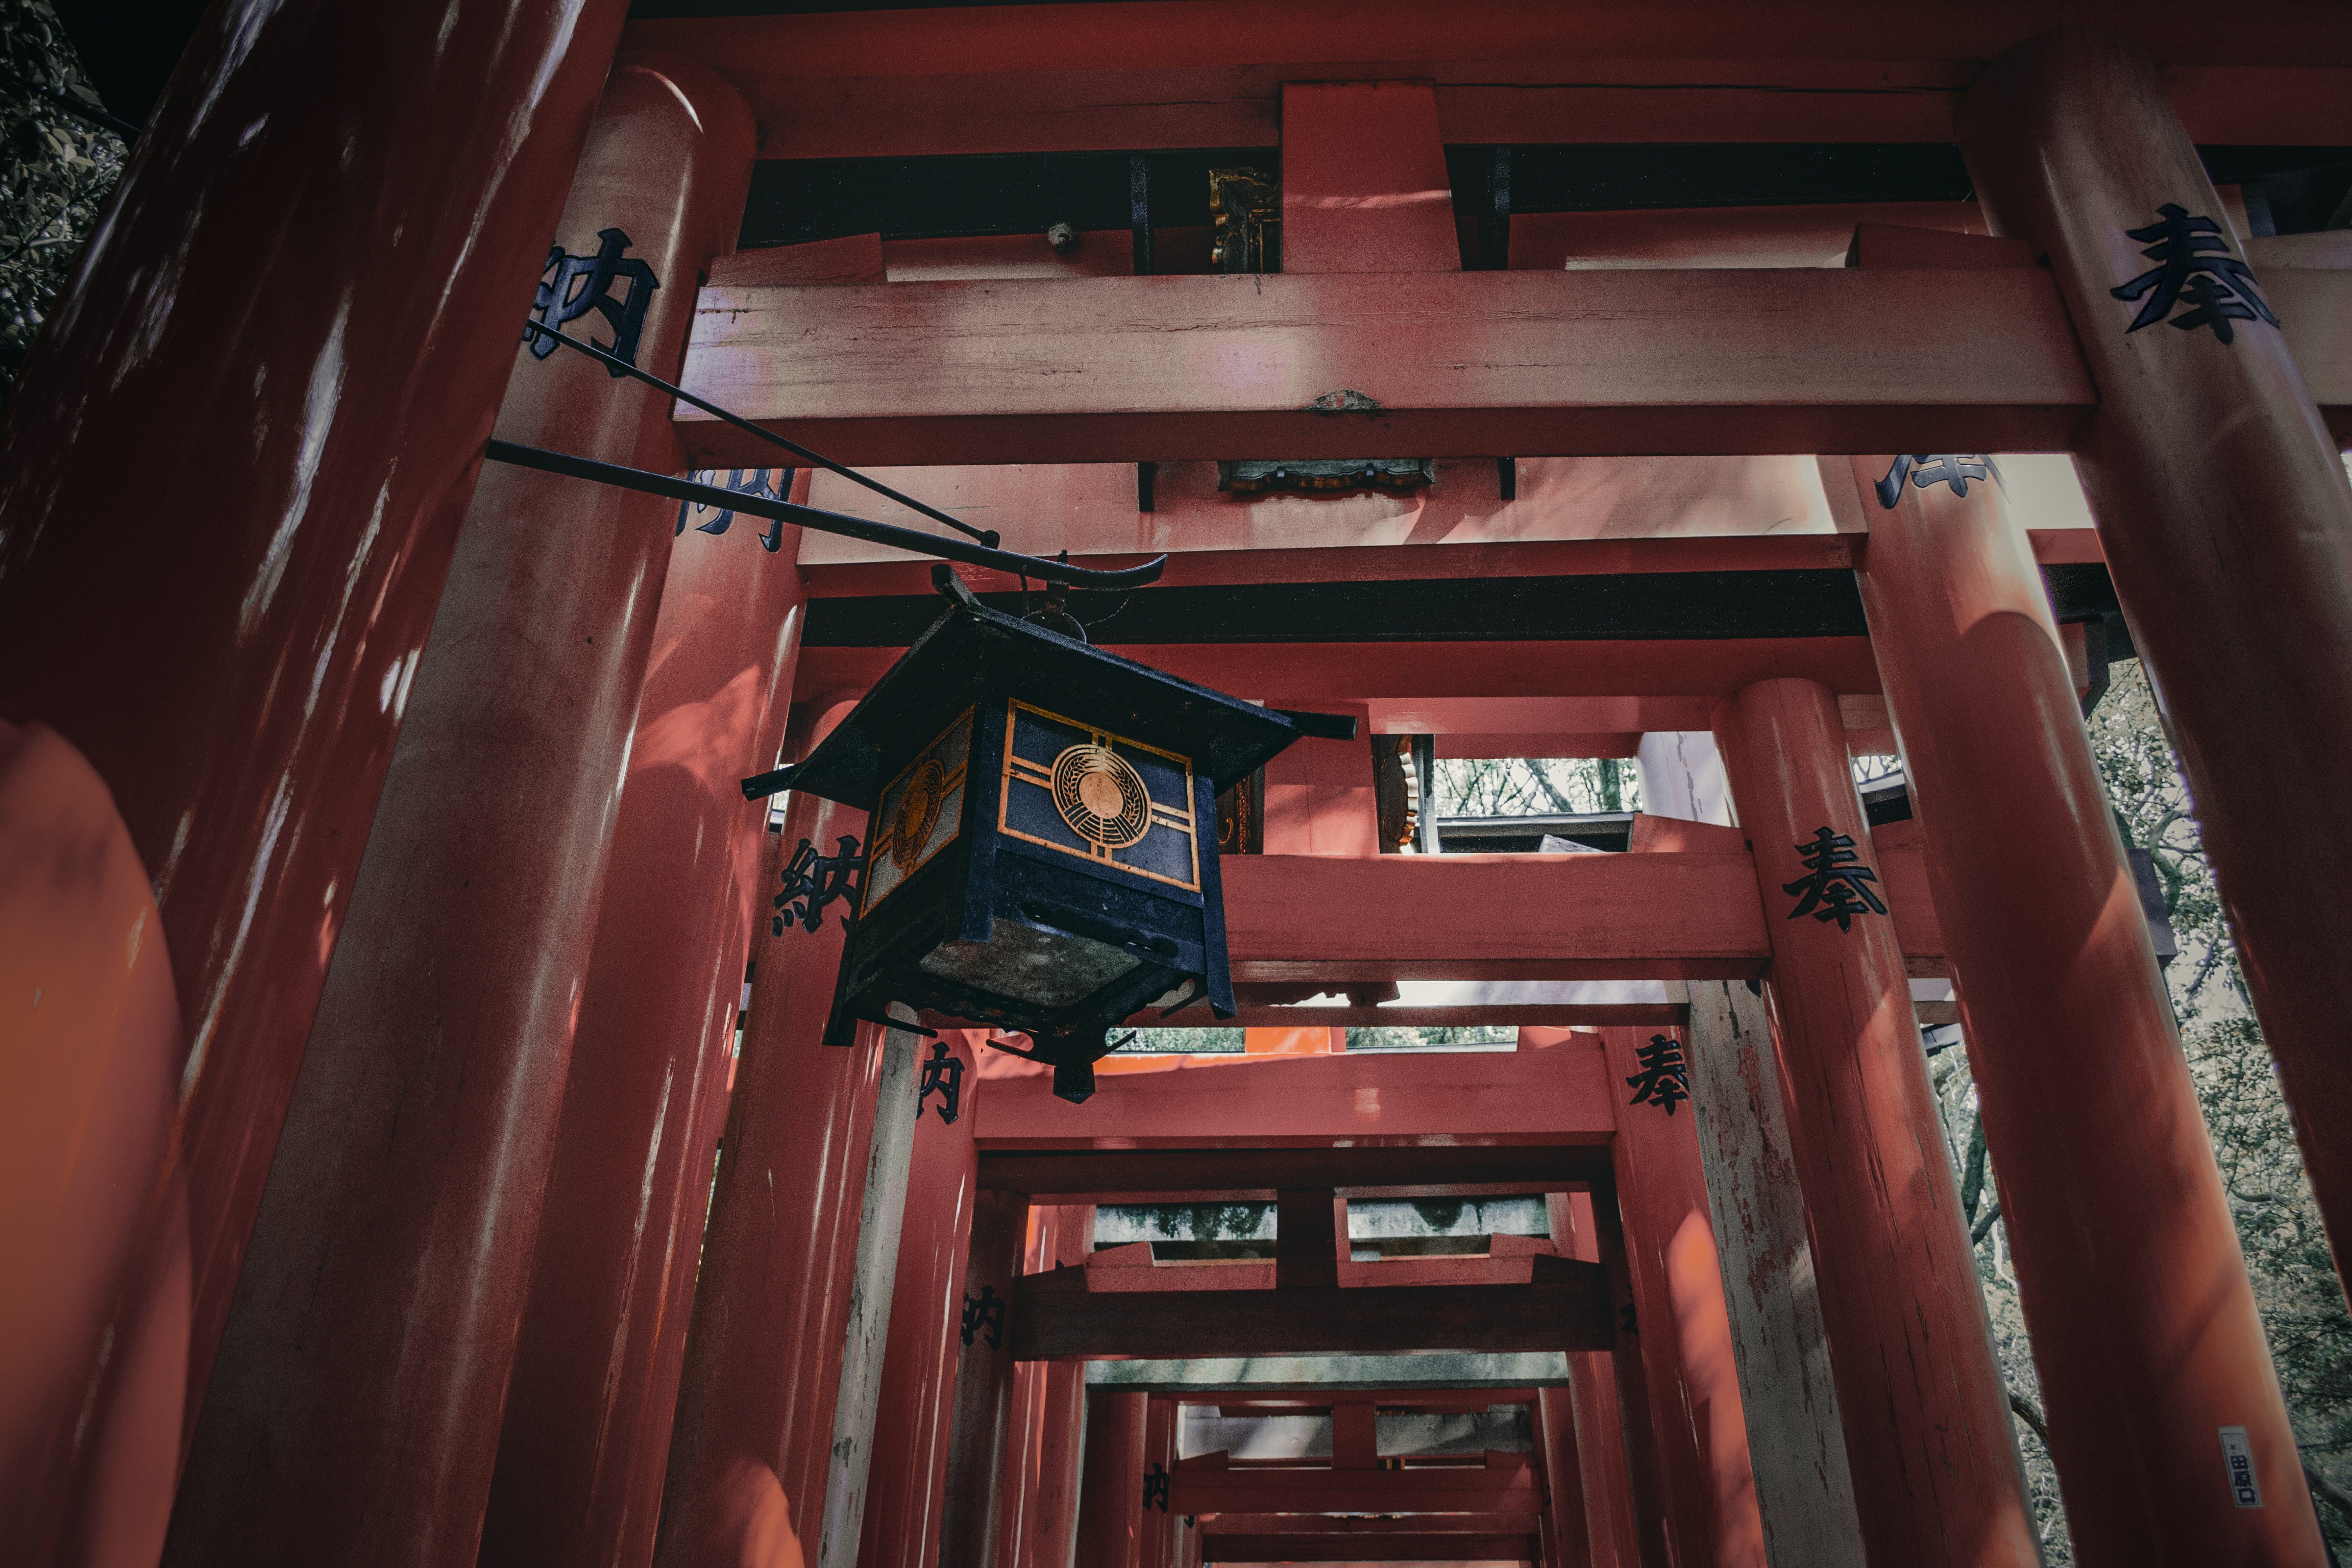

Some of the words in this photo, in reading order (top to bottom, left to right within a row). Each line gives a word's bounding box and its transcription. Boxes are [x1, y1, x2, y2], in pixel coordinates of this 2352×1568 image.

[2110, 203, 2282, 346] 奉
[1782, 826, 1889, 933] 奉
[1626, 1034, 1690, 1116] 奉
